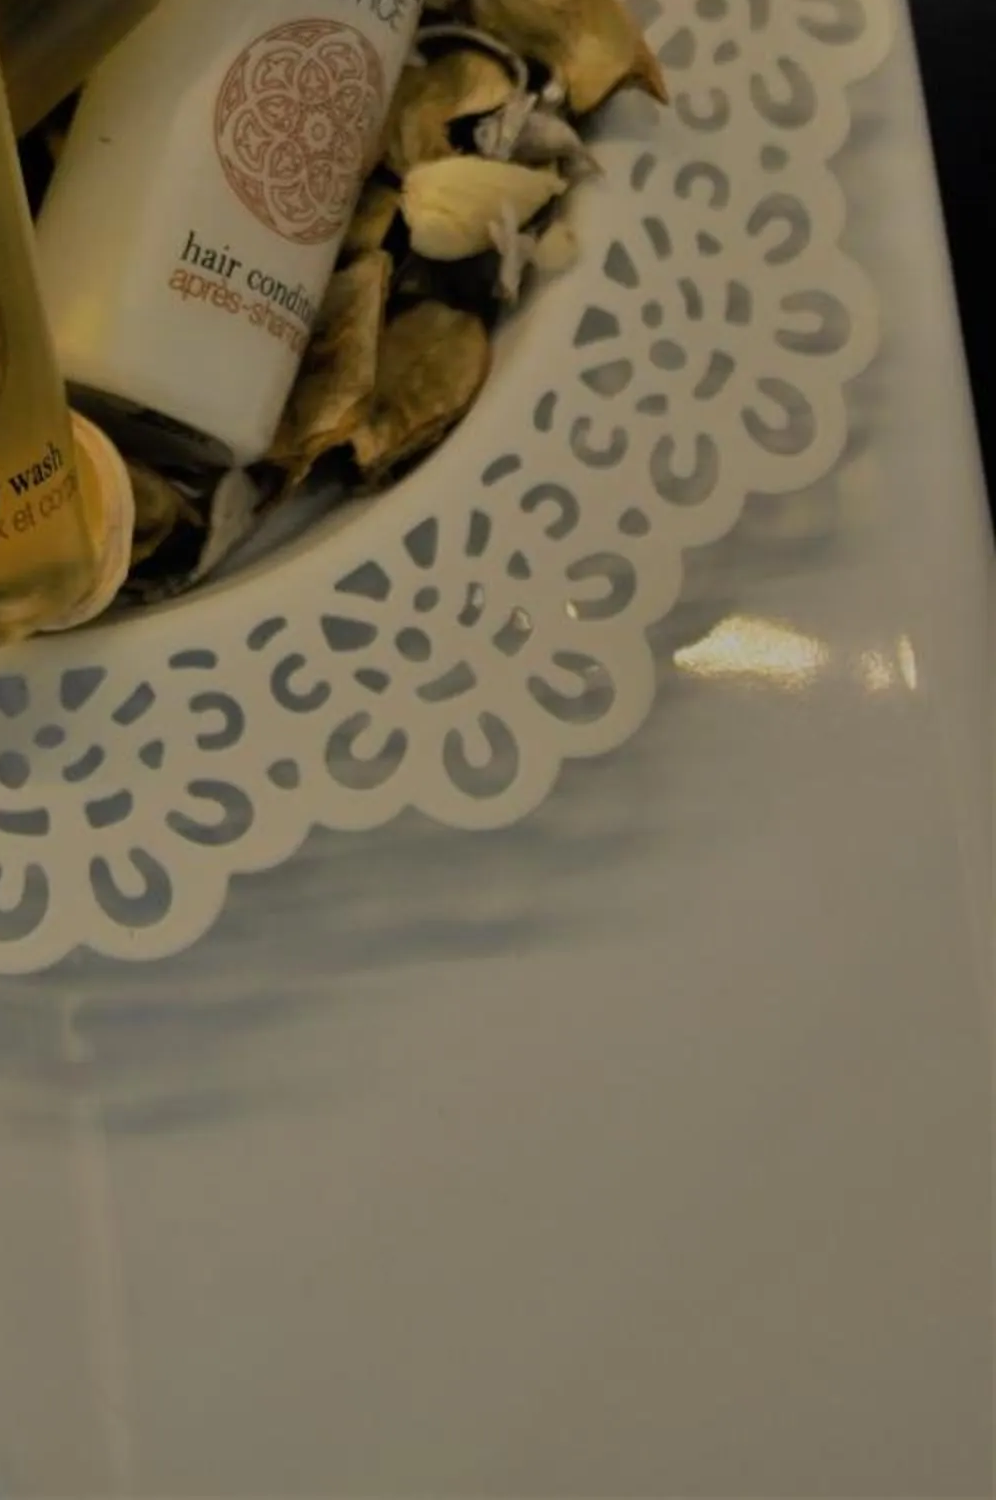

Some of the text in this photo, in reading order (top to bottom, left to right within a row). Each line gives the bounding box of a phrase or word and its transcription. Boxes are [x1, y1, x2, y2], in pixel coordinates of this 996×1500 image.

[180, 230, 242, 278] hair
[8, 441, 65, 497] wash
[13, 502, 46, 533] et
